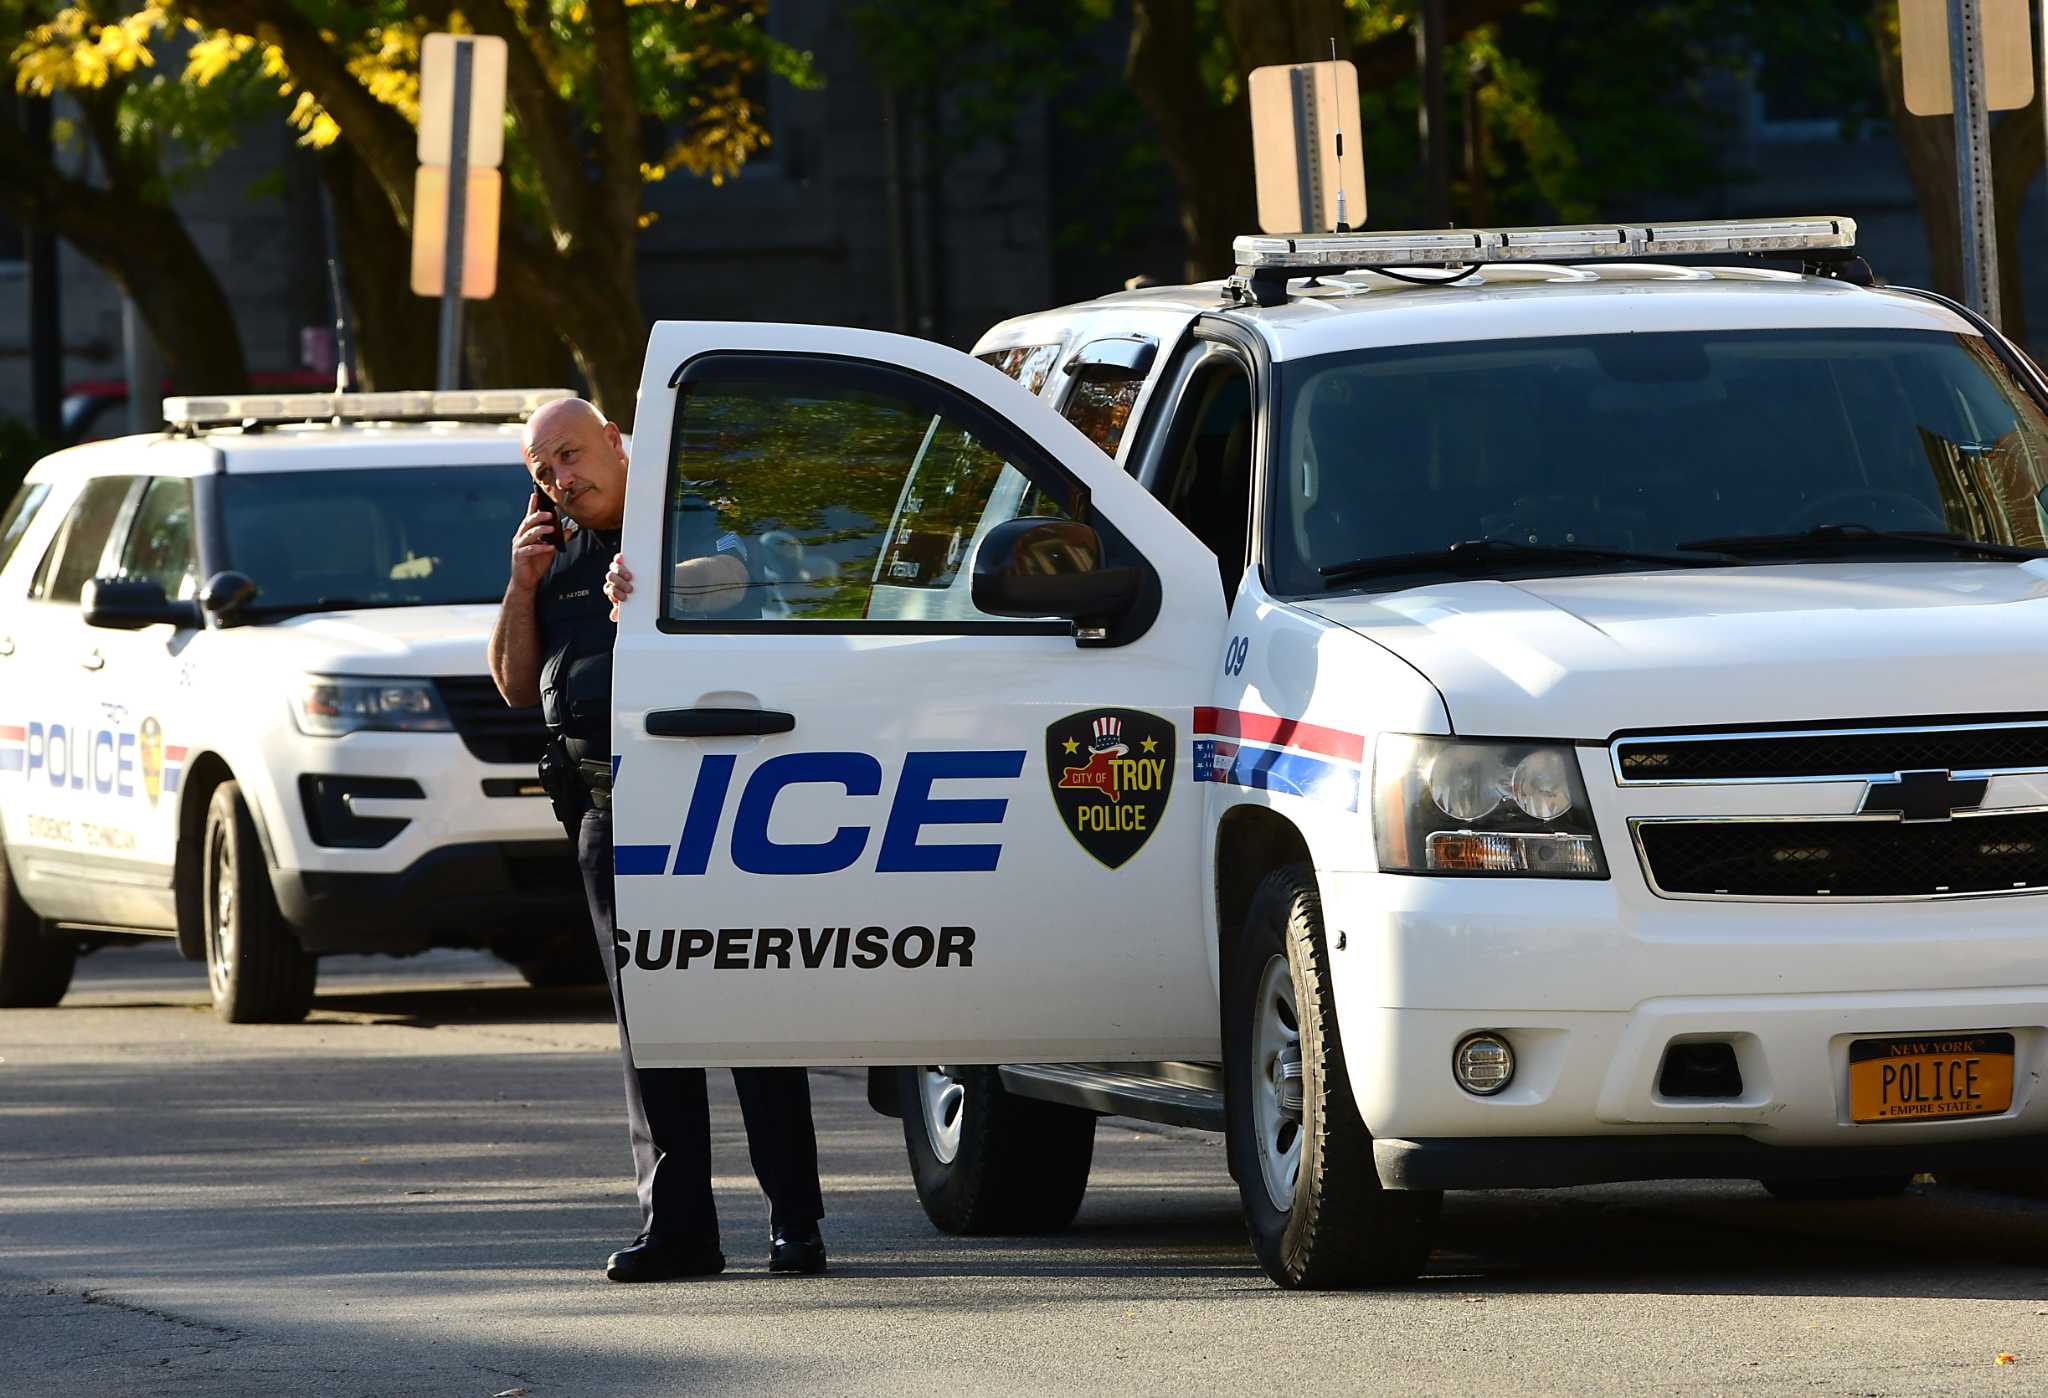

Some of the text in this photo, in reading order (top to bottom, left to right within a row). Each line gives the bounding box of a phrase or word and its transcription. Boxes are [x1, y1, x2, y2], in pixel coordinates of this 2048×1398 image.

[1224, 636, 1249, 676] 09
[26, 721, 136, 797] POLICE
[1072, 758, 1166, 791] CITY OF TROY
[612, 750, 1027, 875] ICE
[1078, 805, 1146, 831] POLICE
[1891, 1039, 1974, 1056] NEW YORK
[1882, 1058, 1980, 1104] POLICE
[1890, 1100, 1973, 1116] EMPIRE STATE
